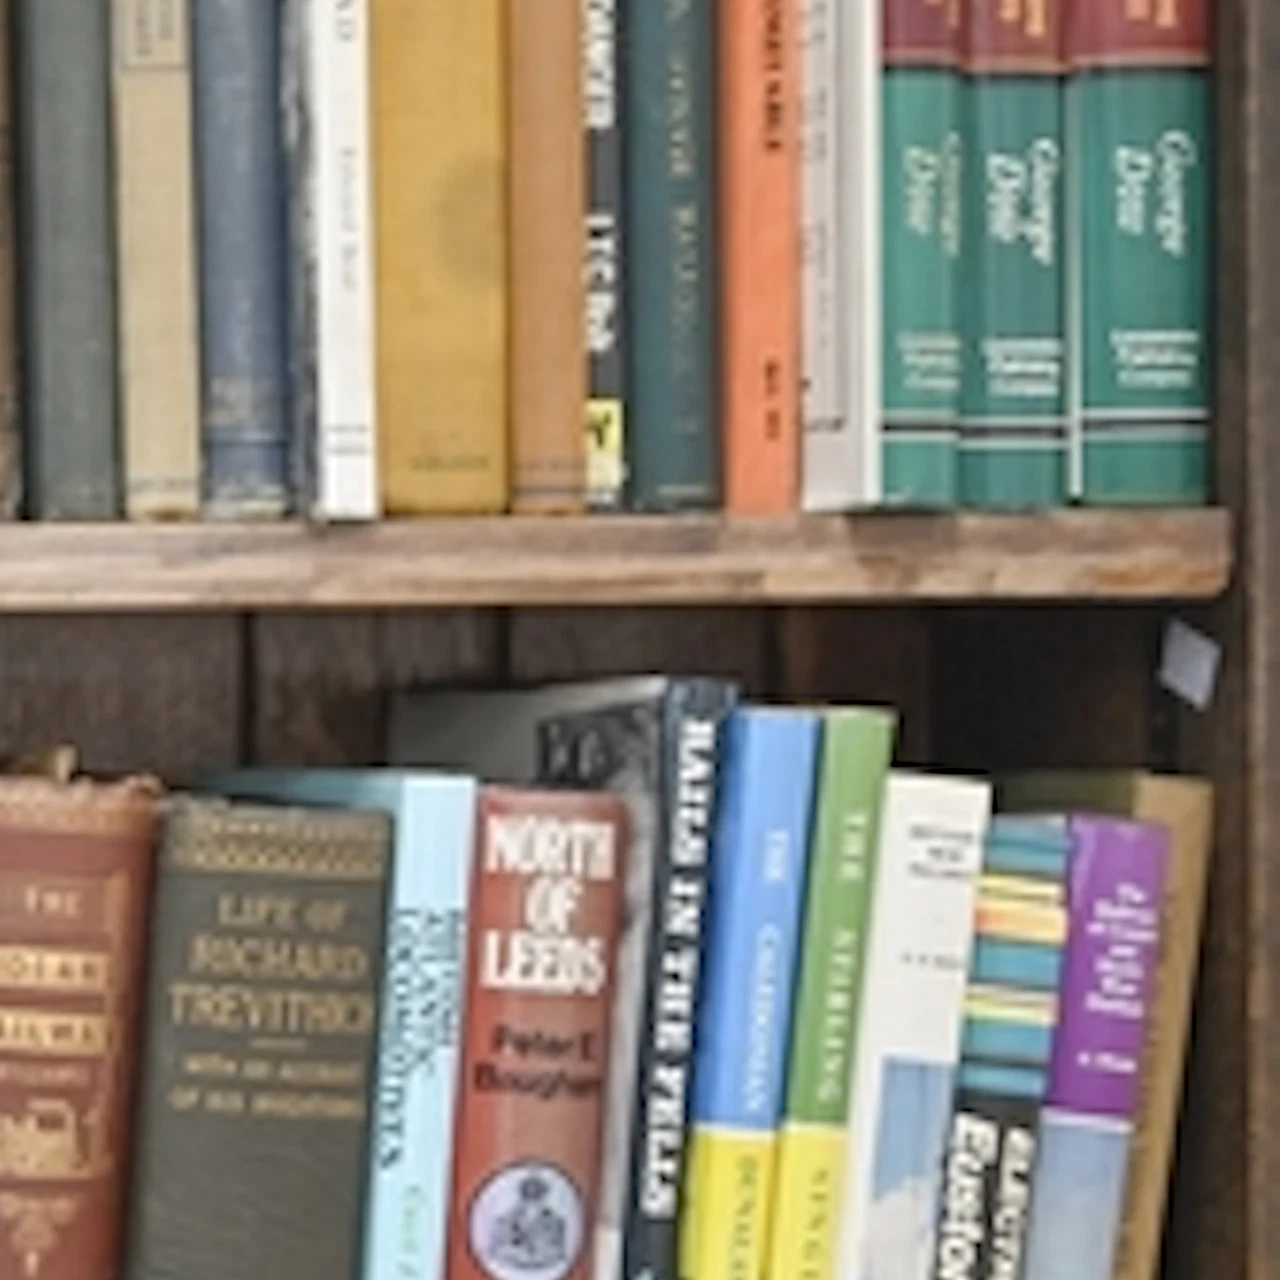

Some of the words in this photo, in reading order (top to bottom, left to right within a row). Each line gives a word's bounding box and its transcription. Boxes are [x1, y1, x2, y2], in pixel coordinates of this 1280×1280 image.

[677, 718, 718, 866] RAILS
[483, 812, 619, 881] NORTH
[840, 811, 870, 887] THE
[218, 892, 298, 927] LIFE
[302, 899, 349, 933] OF
[524, 875, 585, 935] OF
[671, 876, 703, 937] IN
[189, 933, 369, 982] RICHARD
[477, 927, 608, 996] LEEDS
[168, 981, 375, 1034] TREVITHIC
[659, 950, 698, 1052] THE
[816, 925, 857, 1106] STIRLING
[640, 1068, 686, 1220] FELLS
